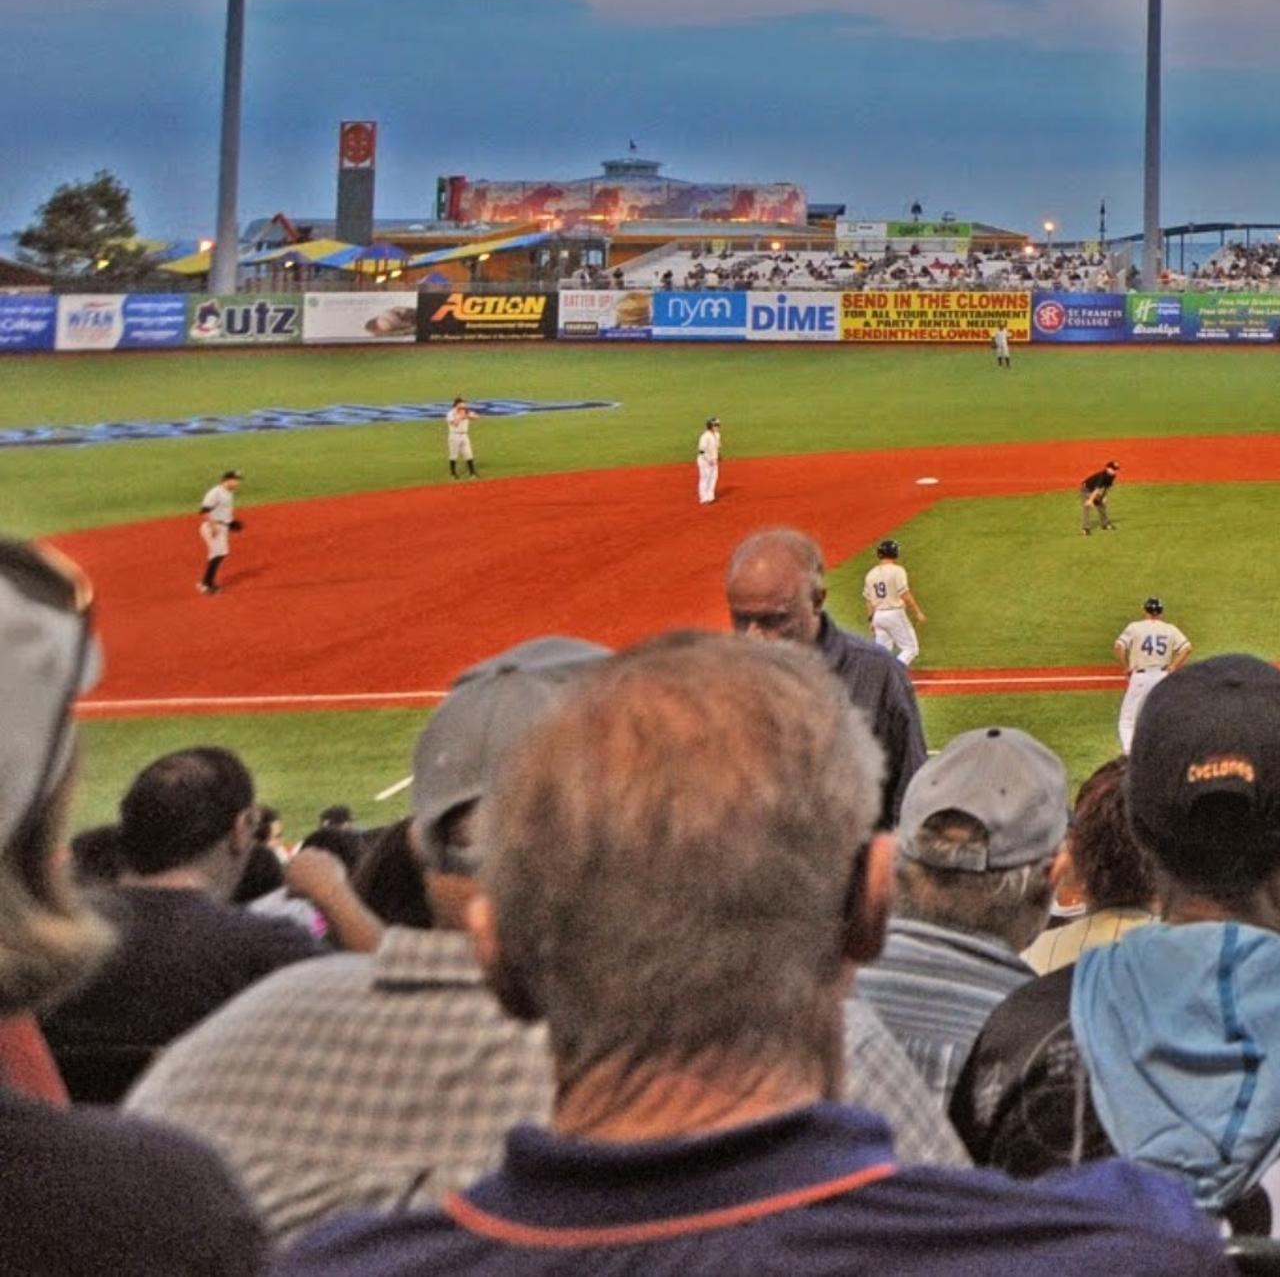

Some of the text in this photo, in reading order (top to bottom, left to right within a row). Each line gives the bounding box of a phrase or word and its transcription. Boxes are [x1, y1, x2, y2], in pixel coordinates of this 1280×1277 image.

[431, 293, 546, 321] ACTION
[842, 293, 1029, 309] SEND IN THE CLOWNS
[843, 310, 1028, 319] FOR ALL YOUR ENTERTAINMENT
[1081, 309, 1123, 318] FRANCIS
[876, 319, 914, 328] PARTY
[1068, 318, 1110, 327] COLLEGE
[872, 581, 887, 599] 19
[1141, 634, 1167, 656] 45
